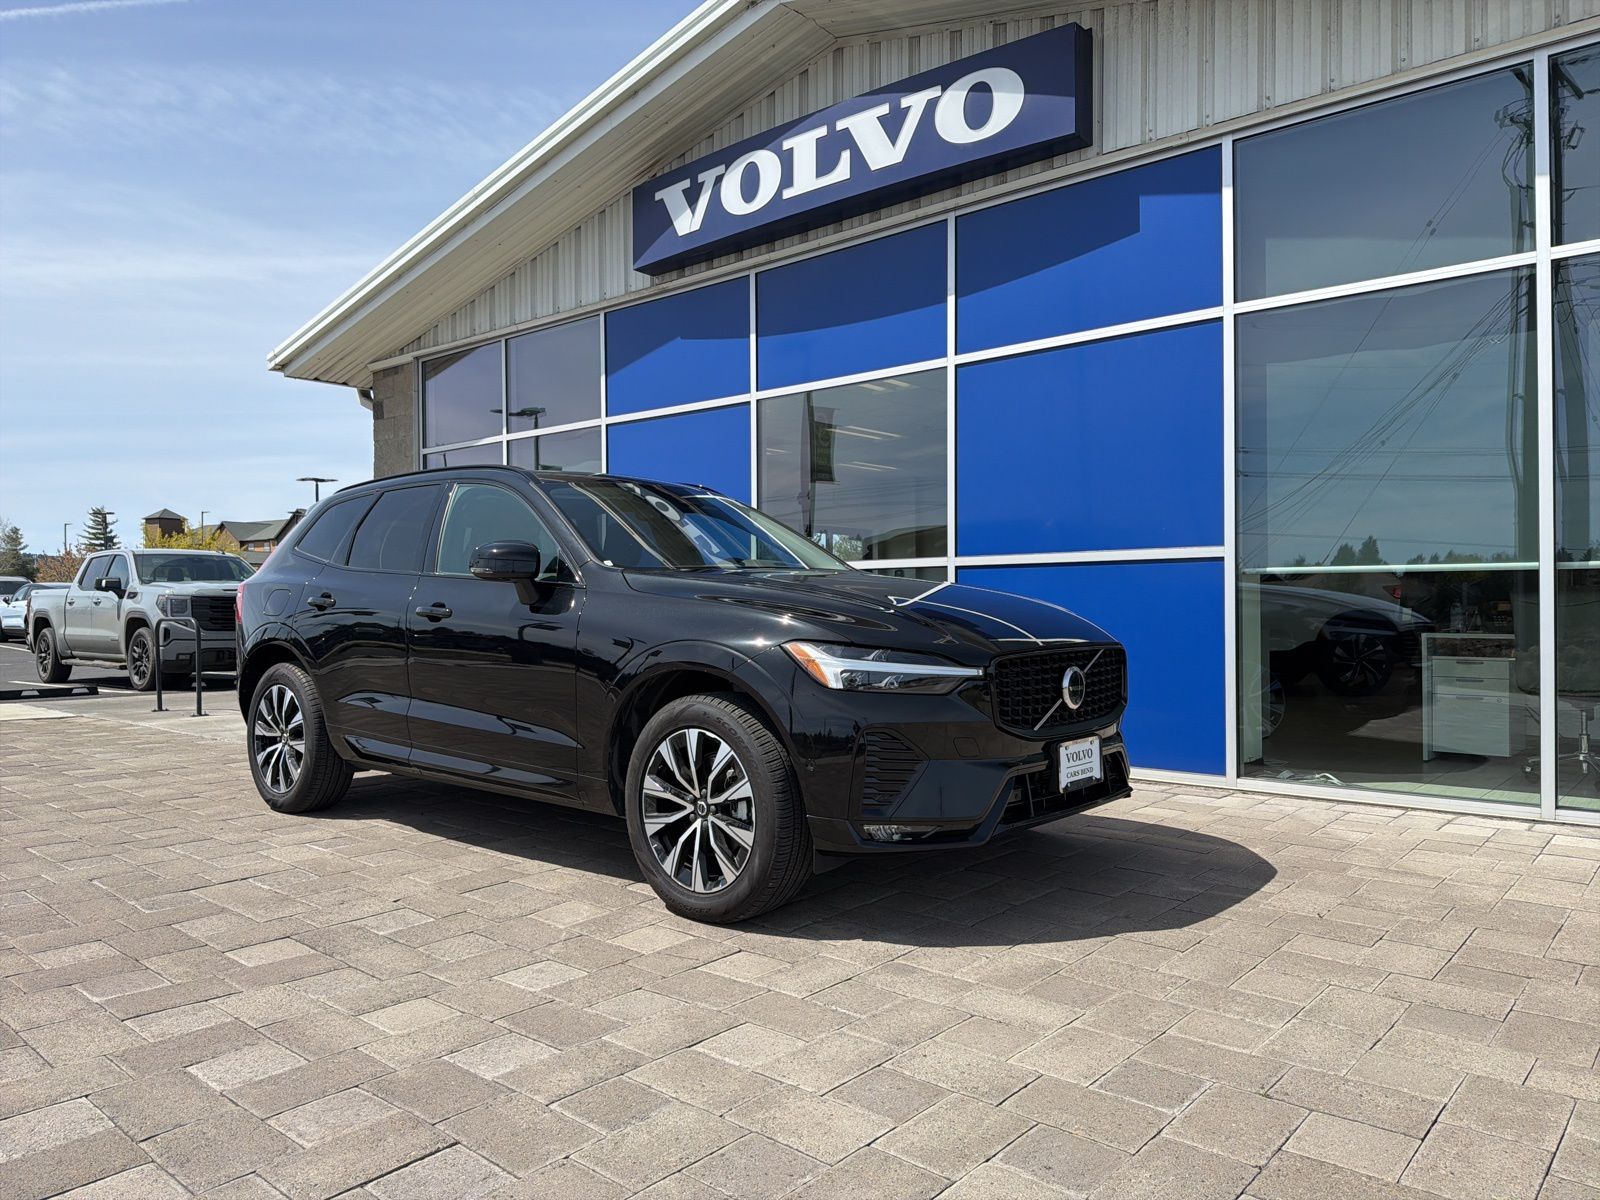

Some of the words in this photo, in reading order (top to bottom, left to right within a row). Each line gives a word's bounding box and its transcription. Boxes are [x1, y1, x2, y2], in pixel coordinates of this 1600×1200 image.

[655, 67, 1025, 236] VOLVO
[1066, 748, 1093, 763] VOLVO
[1066, 770, 1080, 779] CARS
[1080, 766, 1094, 776] BEND
